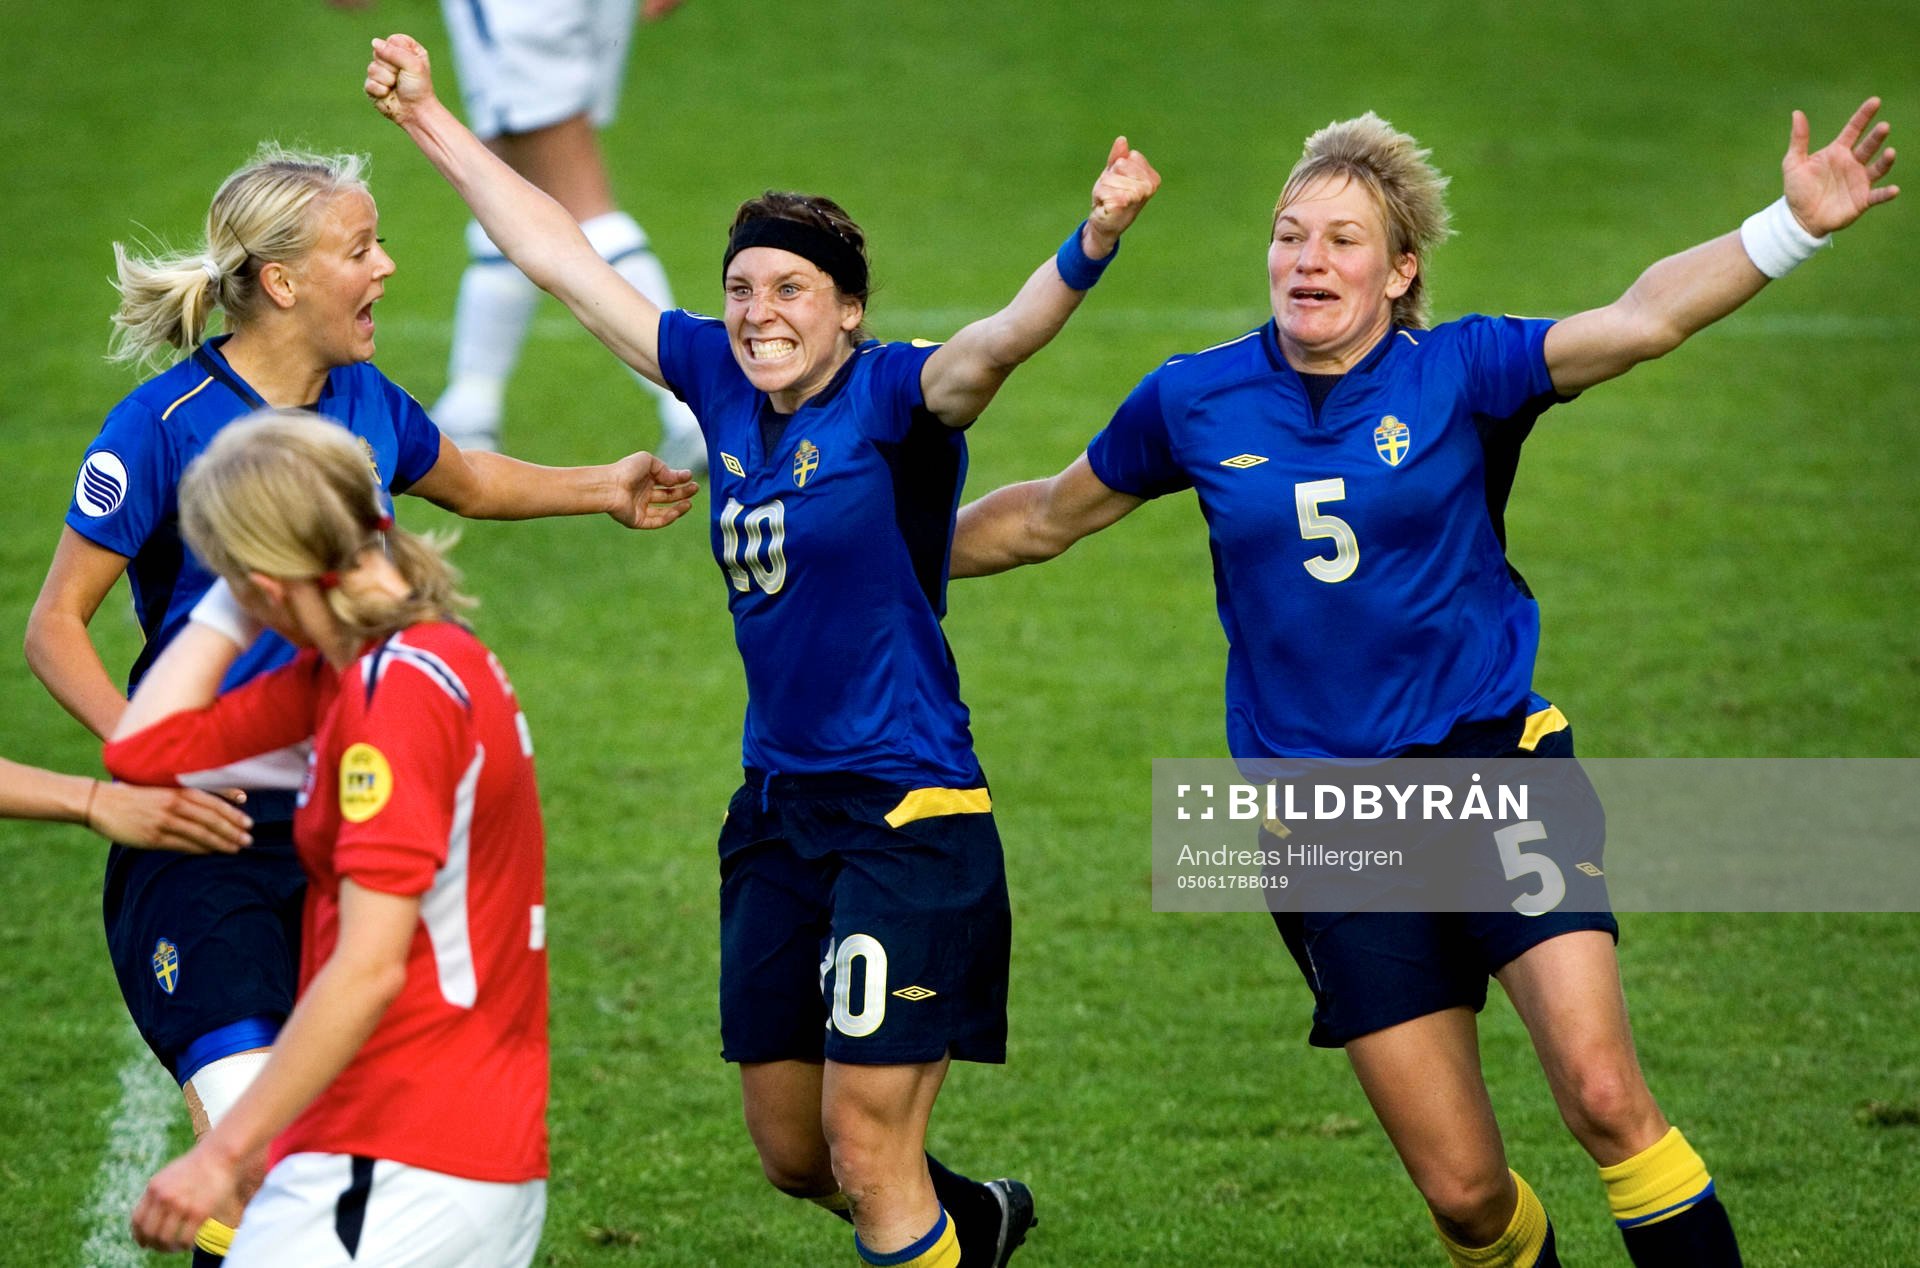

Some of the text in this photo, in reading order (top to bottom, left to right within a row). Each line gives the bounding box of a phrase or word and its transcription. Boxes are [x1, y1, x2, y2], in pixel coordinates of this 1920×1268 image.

[720, 497, 787, 595] 10
[1294, 477, 1360, 583] 5
[1493, 820, 1566, 917] 5
